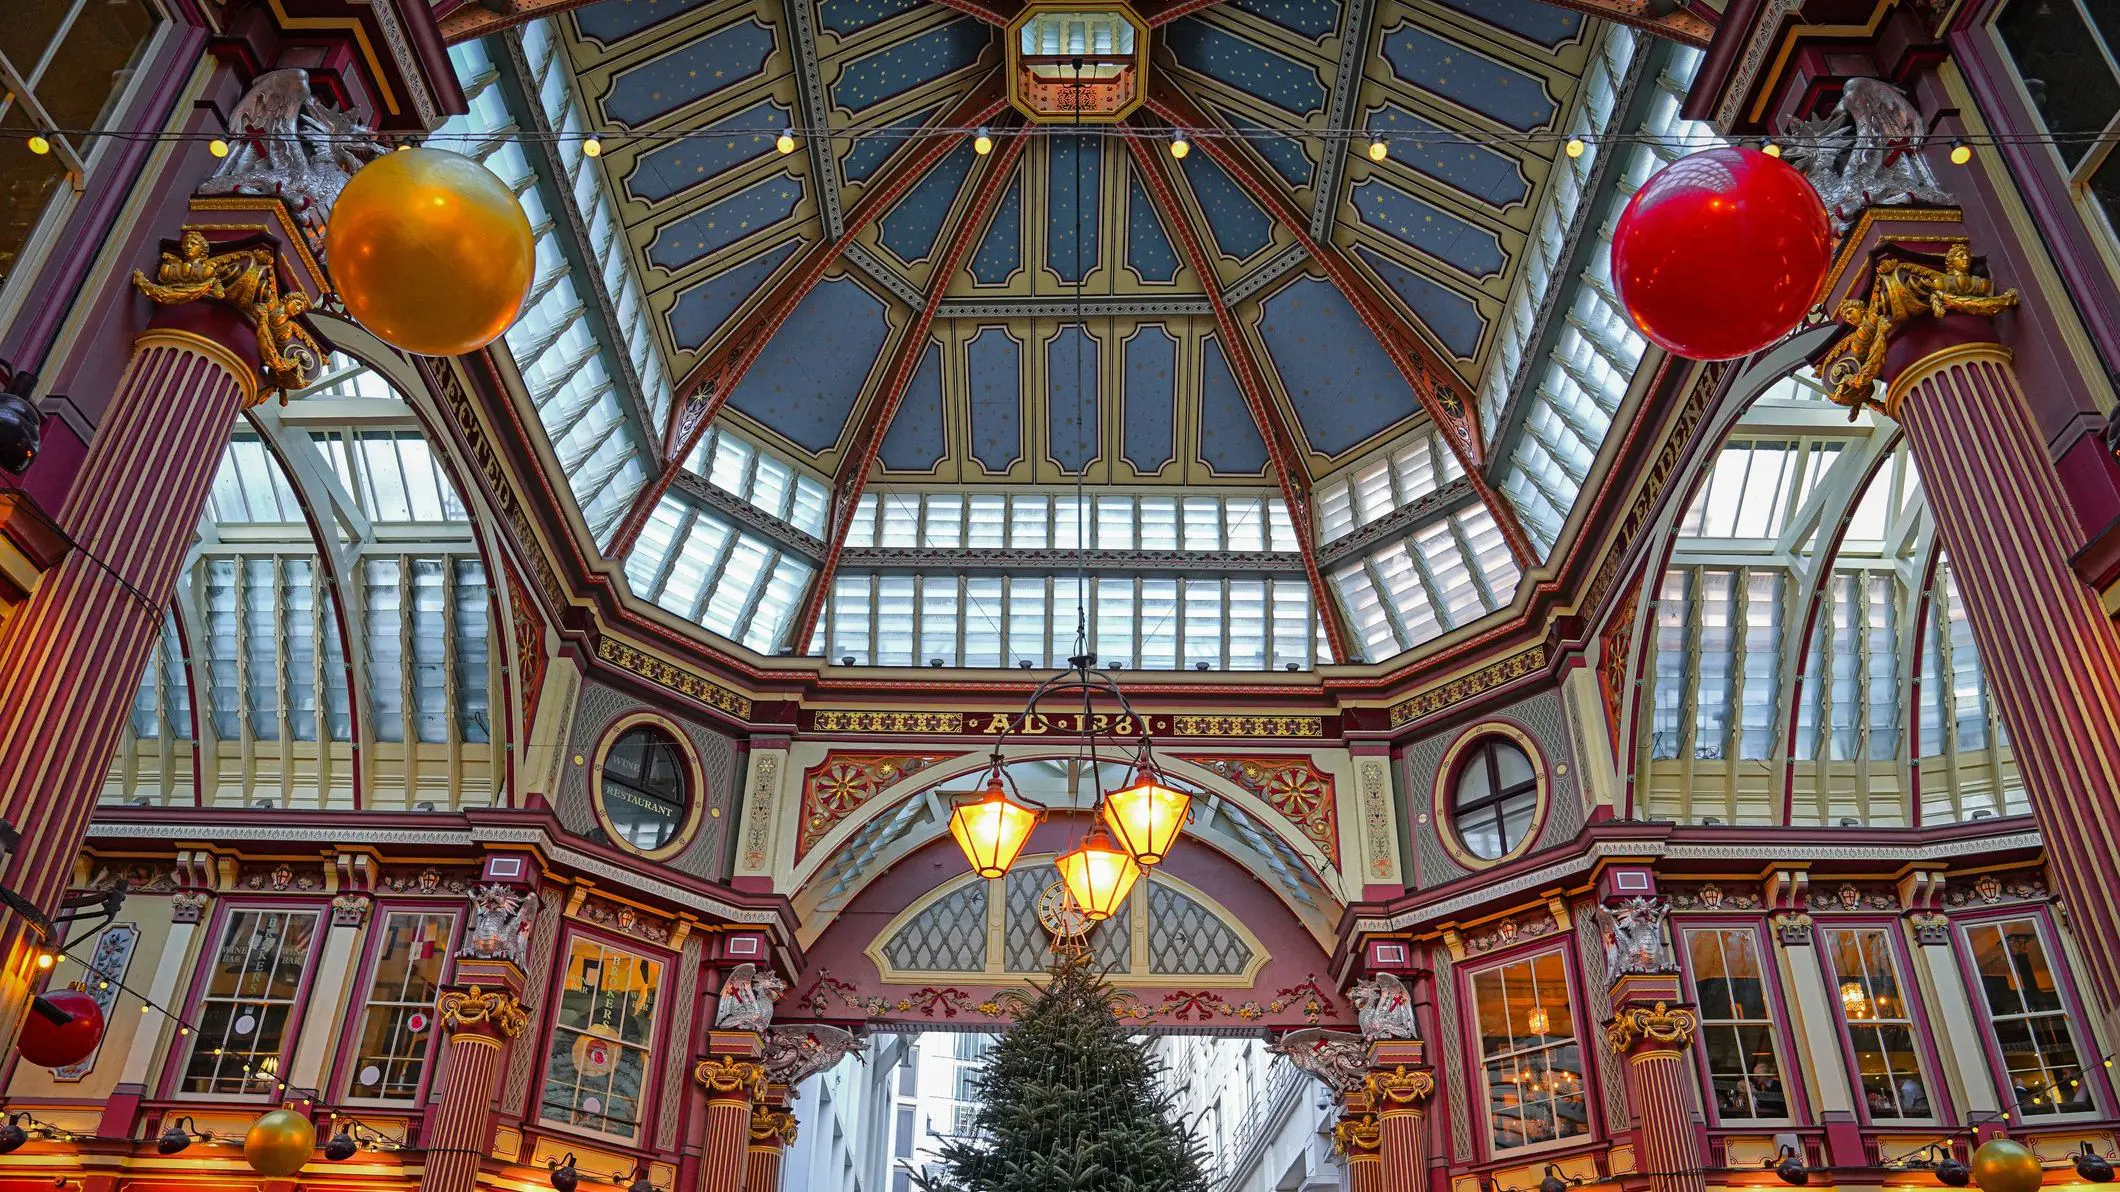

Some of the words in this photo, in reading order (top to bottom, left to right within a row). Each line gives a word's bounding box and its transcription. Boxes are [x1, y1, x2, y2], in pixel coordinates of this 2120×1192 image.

[429, 357, 510, 509] RECTED
[1074, 714, 1154, 736] 1881
[612, 755, 641, 773] WINE
[606, 785, 673, 817] RESTAURANT
[249, 917, 279, 993] BRKERS
[602, 955, 621, 1030] BROKERS
